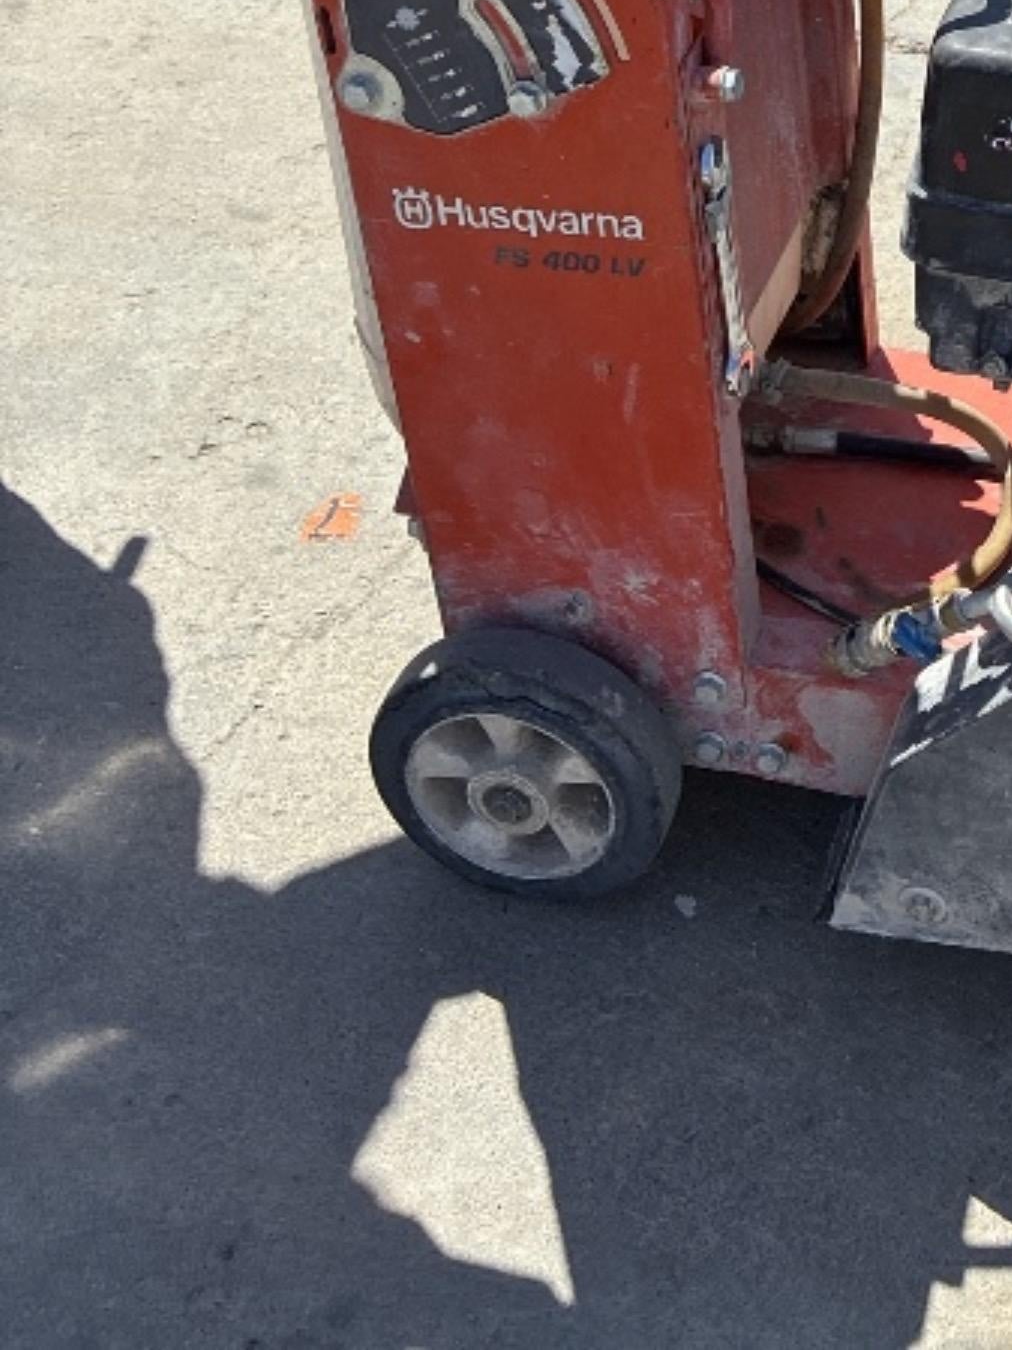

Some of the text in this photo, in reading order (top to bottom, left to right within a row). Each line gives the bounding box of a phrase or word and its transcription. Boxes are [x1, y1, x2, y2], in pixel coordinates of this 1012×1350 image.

[436, 195, 644, 240] Husqvarna
[493, 247, 647, 277] FS 400 LV
